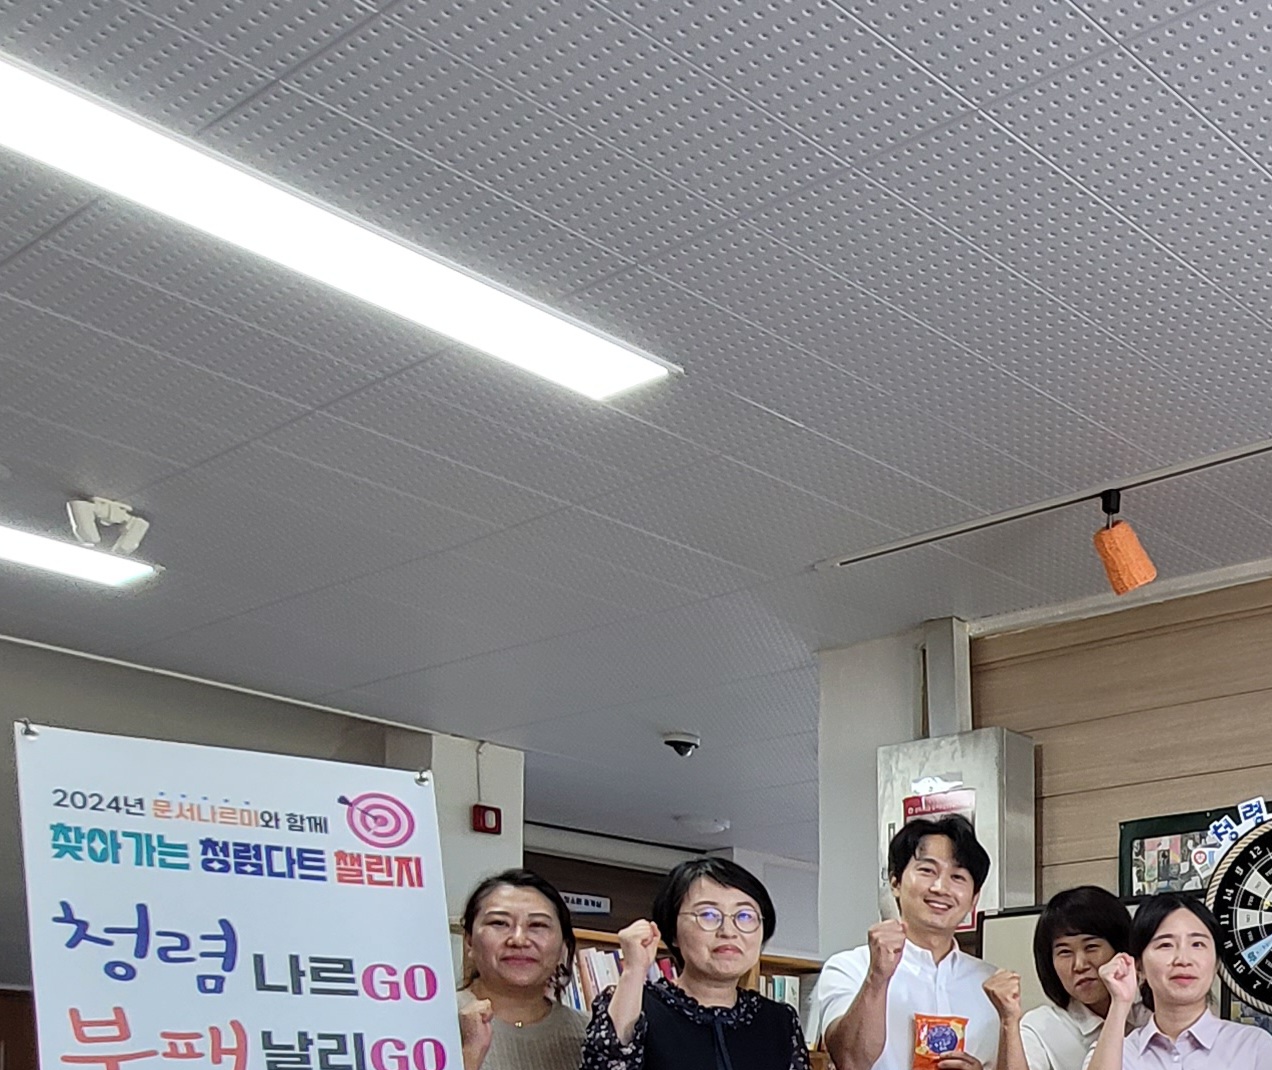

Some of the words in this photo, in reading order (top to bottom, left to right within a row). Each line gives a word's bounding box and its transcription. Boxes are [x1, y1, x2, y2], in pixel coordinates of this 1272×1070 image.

[52, 788, 145, 817] 2024년
[285, 812, 329, 834] 함께
[49, 822, 191, 871] 찾아가는
[199, 837, 328, 882] 청렴다트
[334, 850, 424, 888] 챌린지
[1249, 846, 1263, 859] 12
[1223, 888, 1234, 901] 14
[1220, 913, 1229, 925] 11
[51, 900, 239, 994] 청렴
[253, 953, 438, 1002] 나르GO
